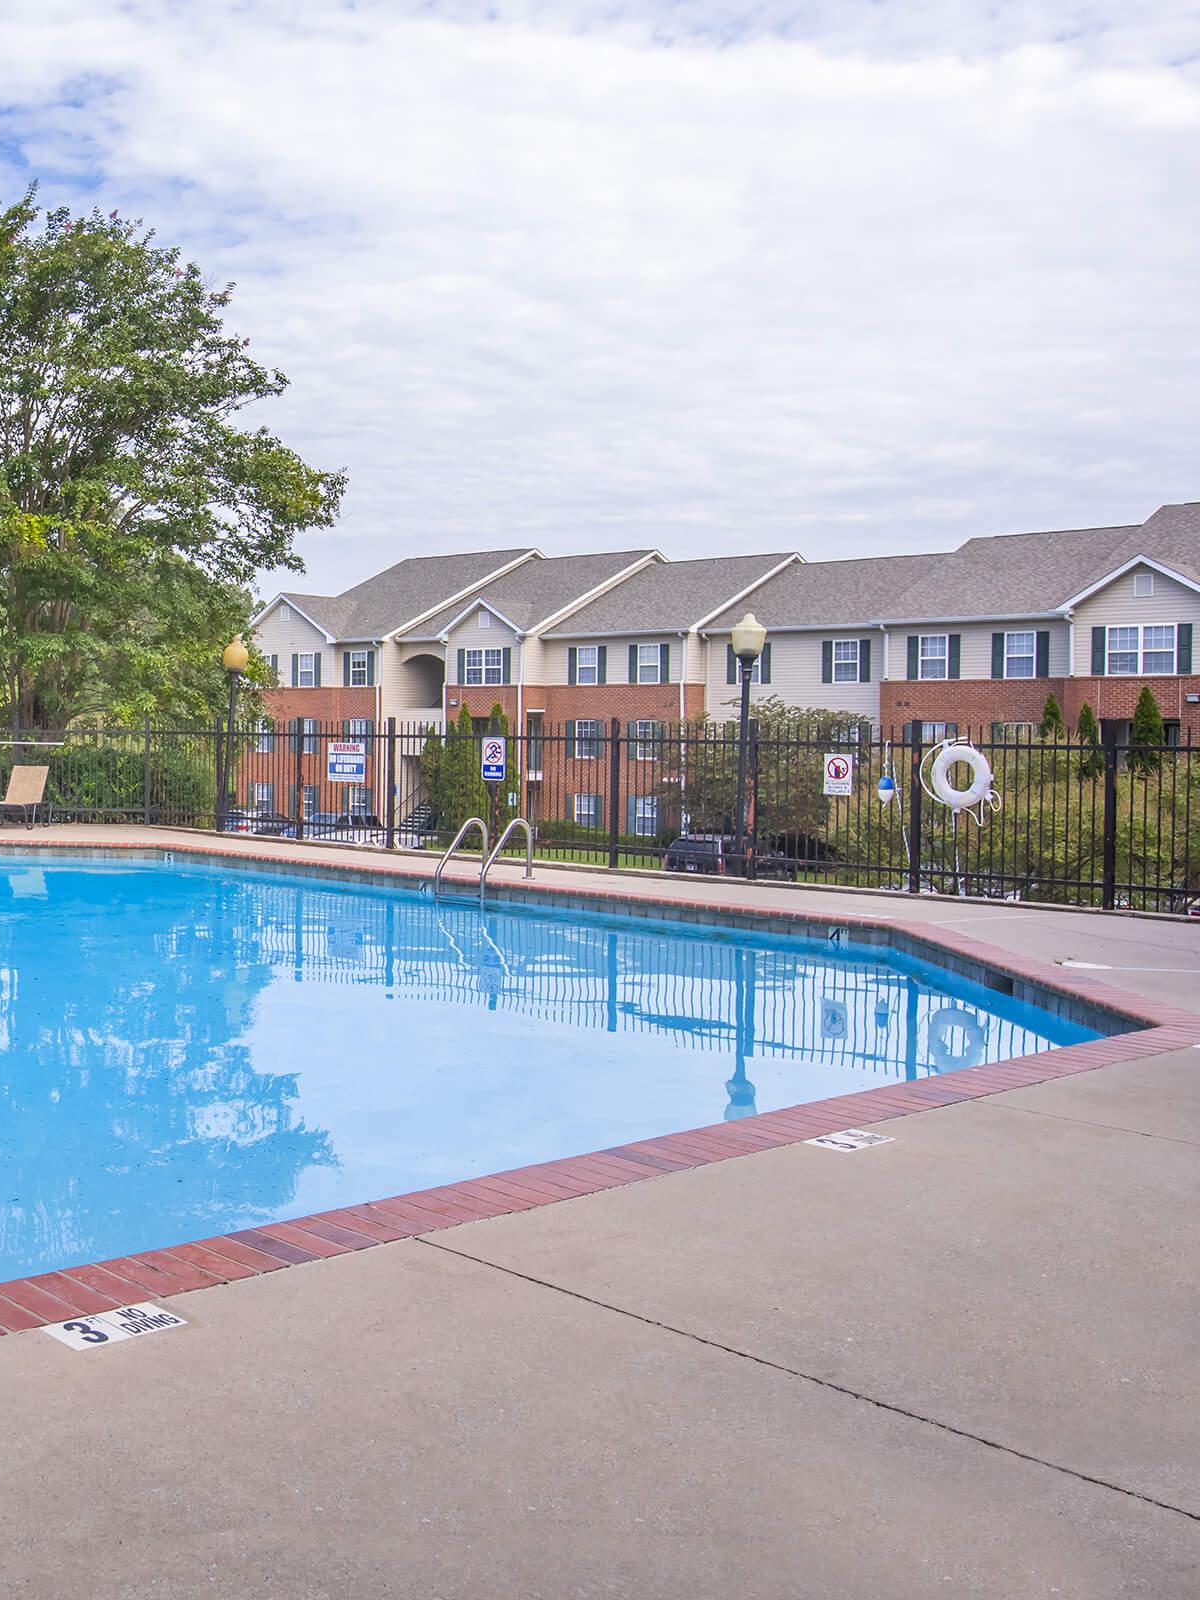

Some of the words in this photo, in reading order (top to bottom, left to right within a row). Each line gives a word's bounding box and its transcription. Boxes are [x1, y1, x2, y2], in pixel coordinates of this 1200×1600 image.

[333, 743, 360, 752] WARNING
[829, 927, 840, 941] 4
[116, 1307, 147, 1321] NO
[120, 1313, 181, 1335] DIVING
[63, 1321, 109, 1344] 3
